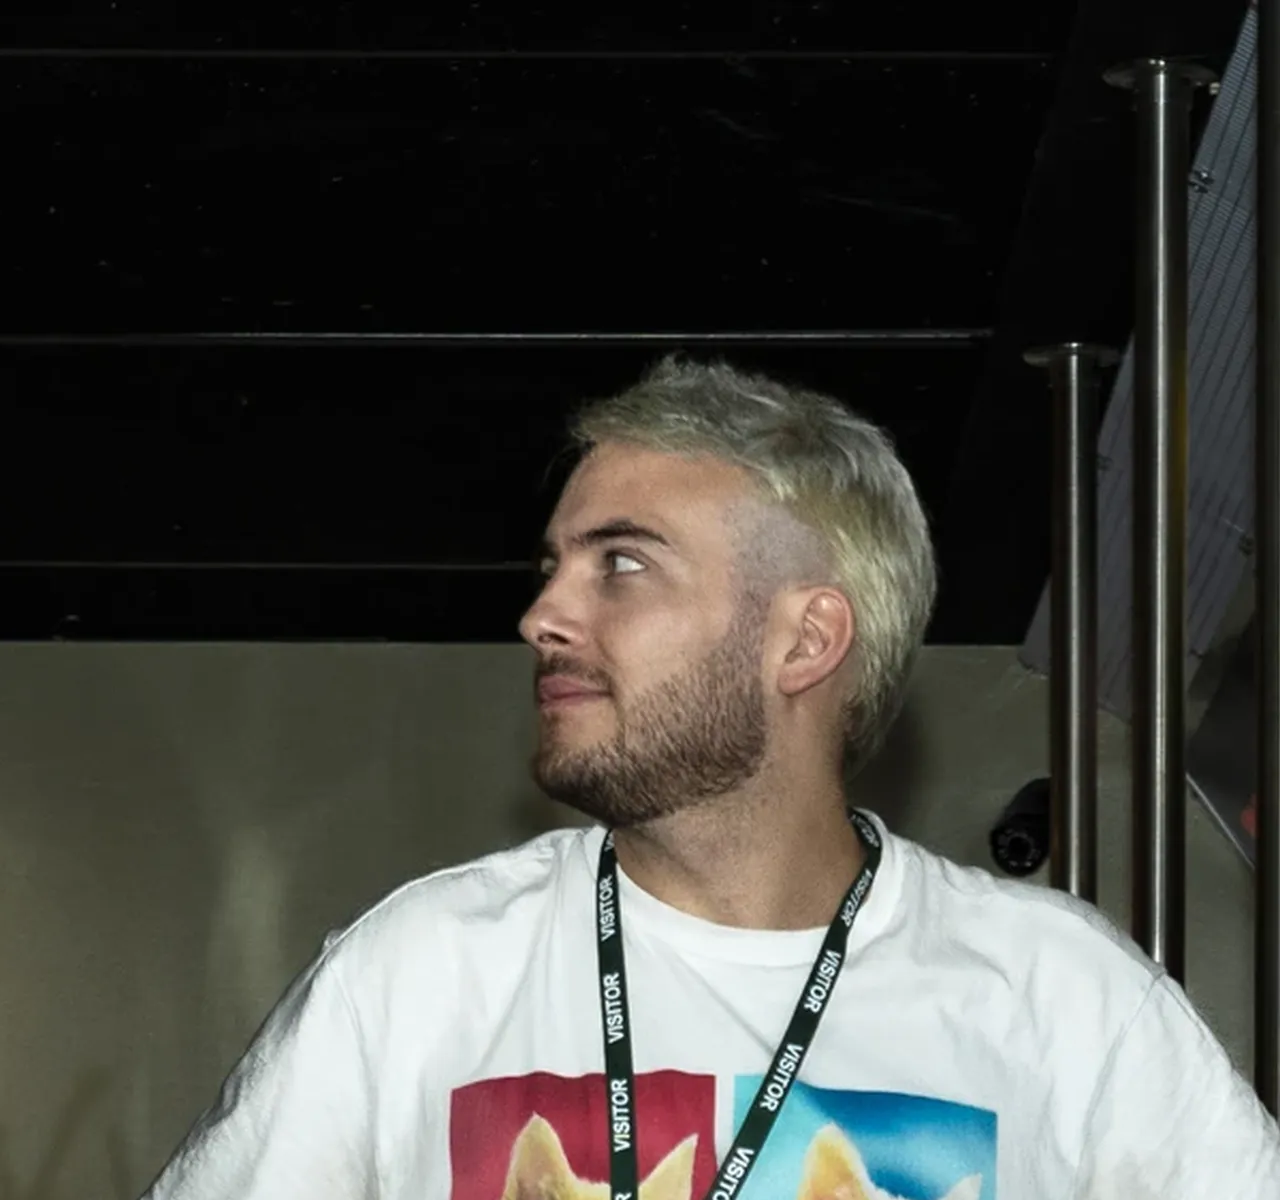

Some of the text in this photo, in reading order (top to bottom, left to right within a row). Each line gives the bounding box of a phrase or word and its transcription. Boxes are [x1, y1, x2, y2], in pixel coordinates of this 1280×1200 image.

[599, 874, 616, 942] VISITOR
[603, 972, 625, 1044] VISITOR
[803, 949, 842, 1014] VISITOR
[760, 1043, 804, 1112] VISITOR
[610, 1079, 631, 1152] VISITOR
